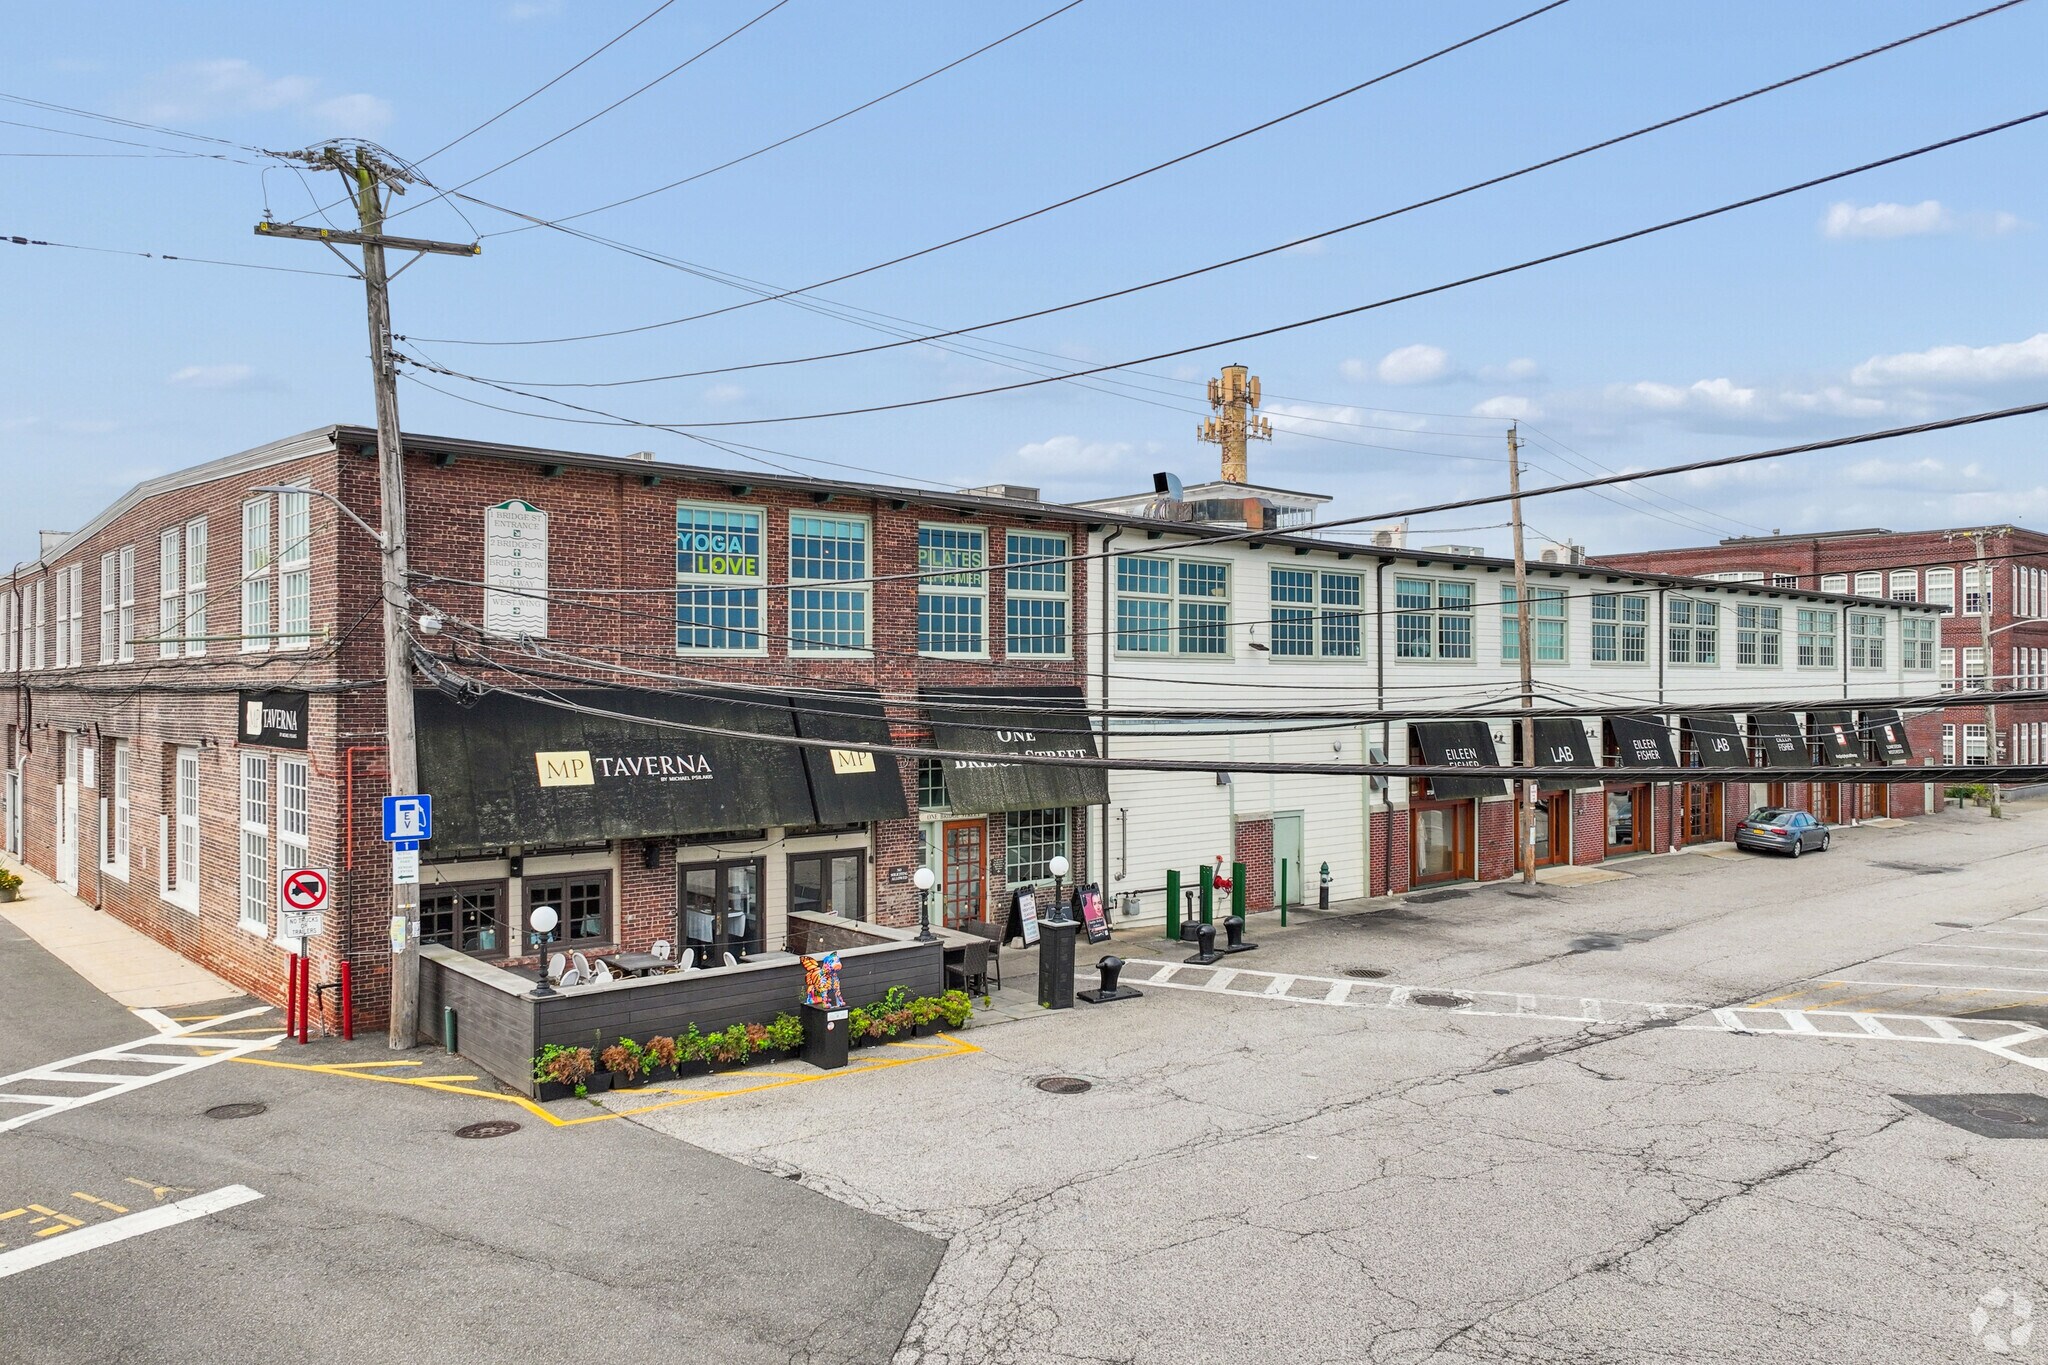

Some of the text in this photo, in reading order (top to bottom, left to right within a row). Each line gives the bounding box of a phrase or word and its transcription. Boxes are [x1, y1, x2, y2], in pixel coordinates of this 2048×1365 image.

[496, 511, 530, 521] BRIDGE
[494, 519, 540, 530] ENTRANCE
[497, 539, 530, 549] BRIDGE
[678, 532, 743, 553] YOGA
[489, 558, 544, 569] BRIDGE ROW
[698, 555, 756, 576] LOVE
[516, 579, 535, 588] WAY
[492, 598, 541, 607] WEST WING
[262, 708, 298, 730] TAVERNA
[996, 731, 1036, 742] ONE
[1632, 738, 1657, 750] EILEEN
[1711, 737, 1730, 752] LAB
[838, 750, 868, 768] MP
[1445, 747, 1478, 761] EILEEN
[1550, 745, 1574, 763] LAB
[1636, 749, 1661, 761] FISHER
[547, 754, 712, 779] MP TAVERNA
[292, 927, 317, 935] TRAERS
